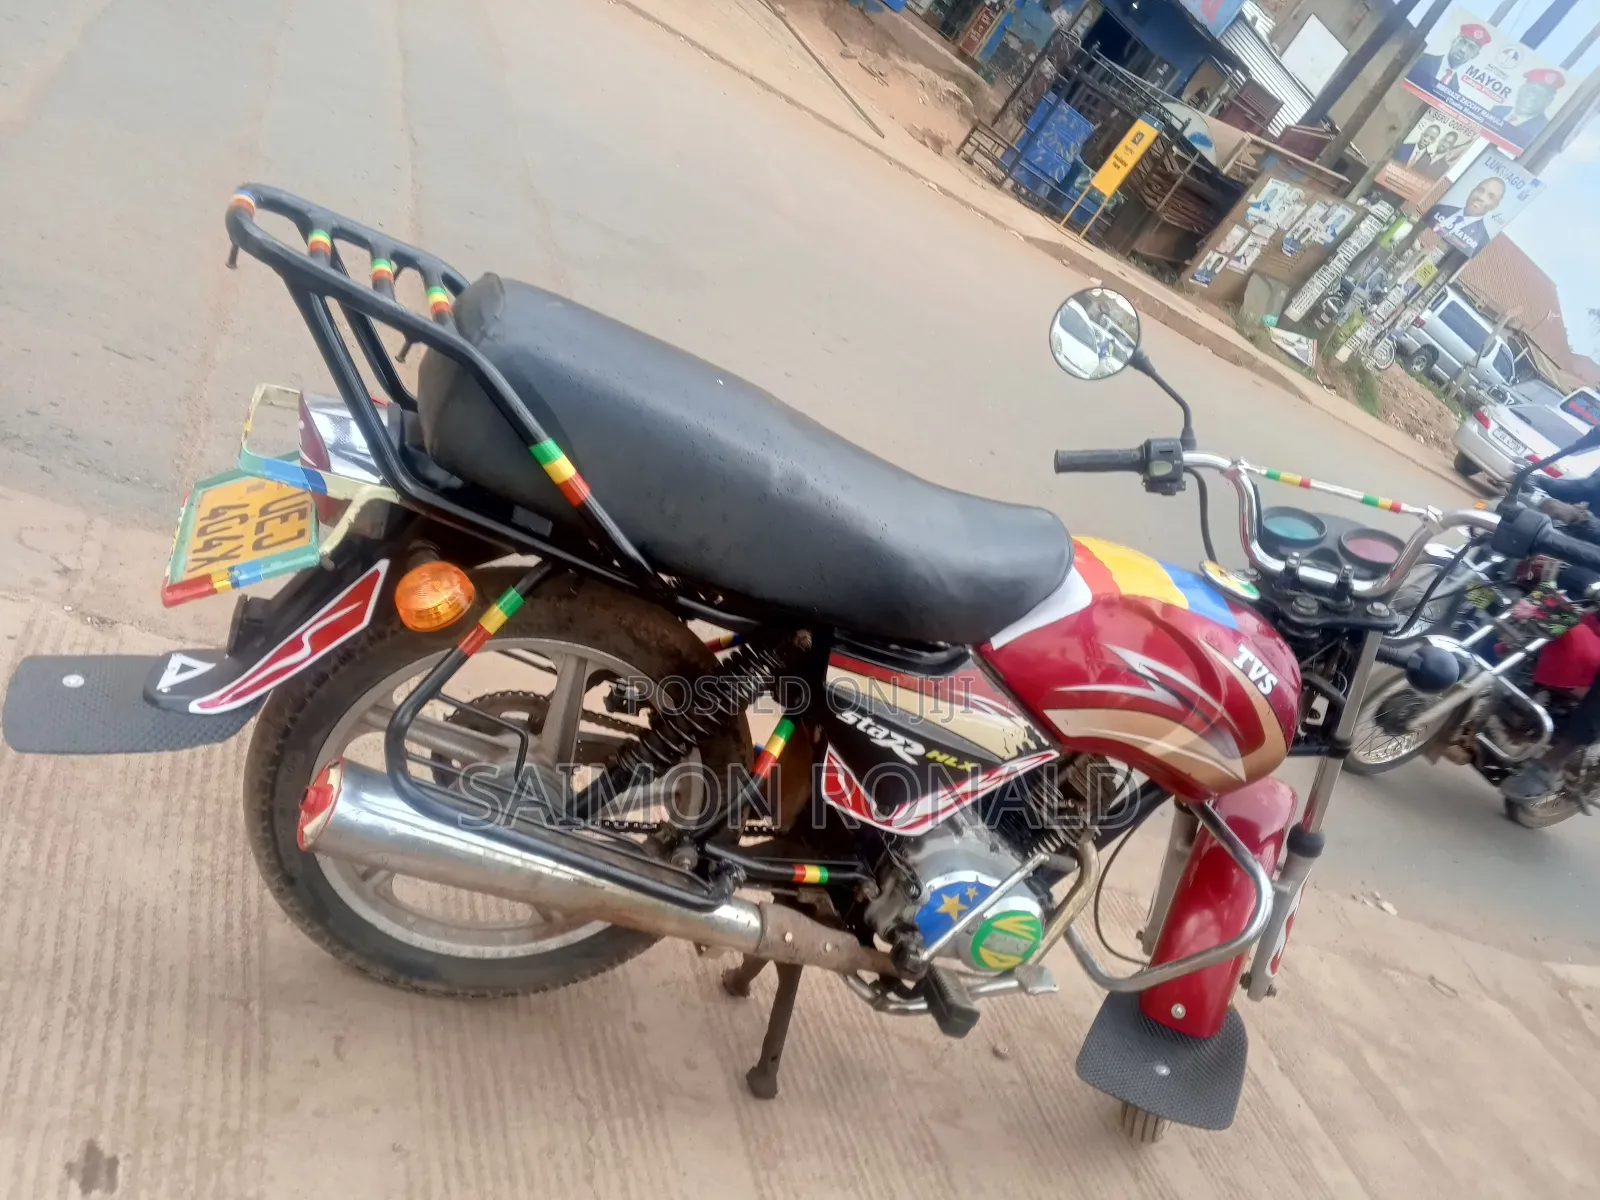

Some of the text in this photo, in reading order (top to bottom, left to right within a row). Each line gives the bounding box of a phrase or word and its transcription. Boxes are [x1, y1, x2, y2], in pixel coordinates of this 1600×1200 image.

[1465, 65, 1512, 98] MAYOR
[252, 491, 309, 552] UEJ
[1232, 642, 1277, 695] TVS
[925, 750, 979, 773] HLX
